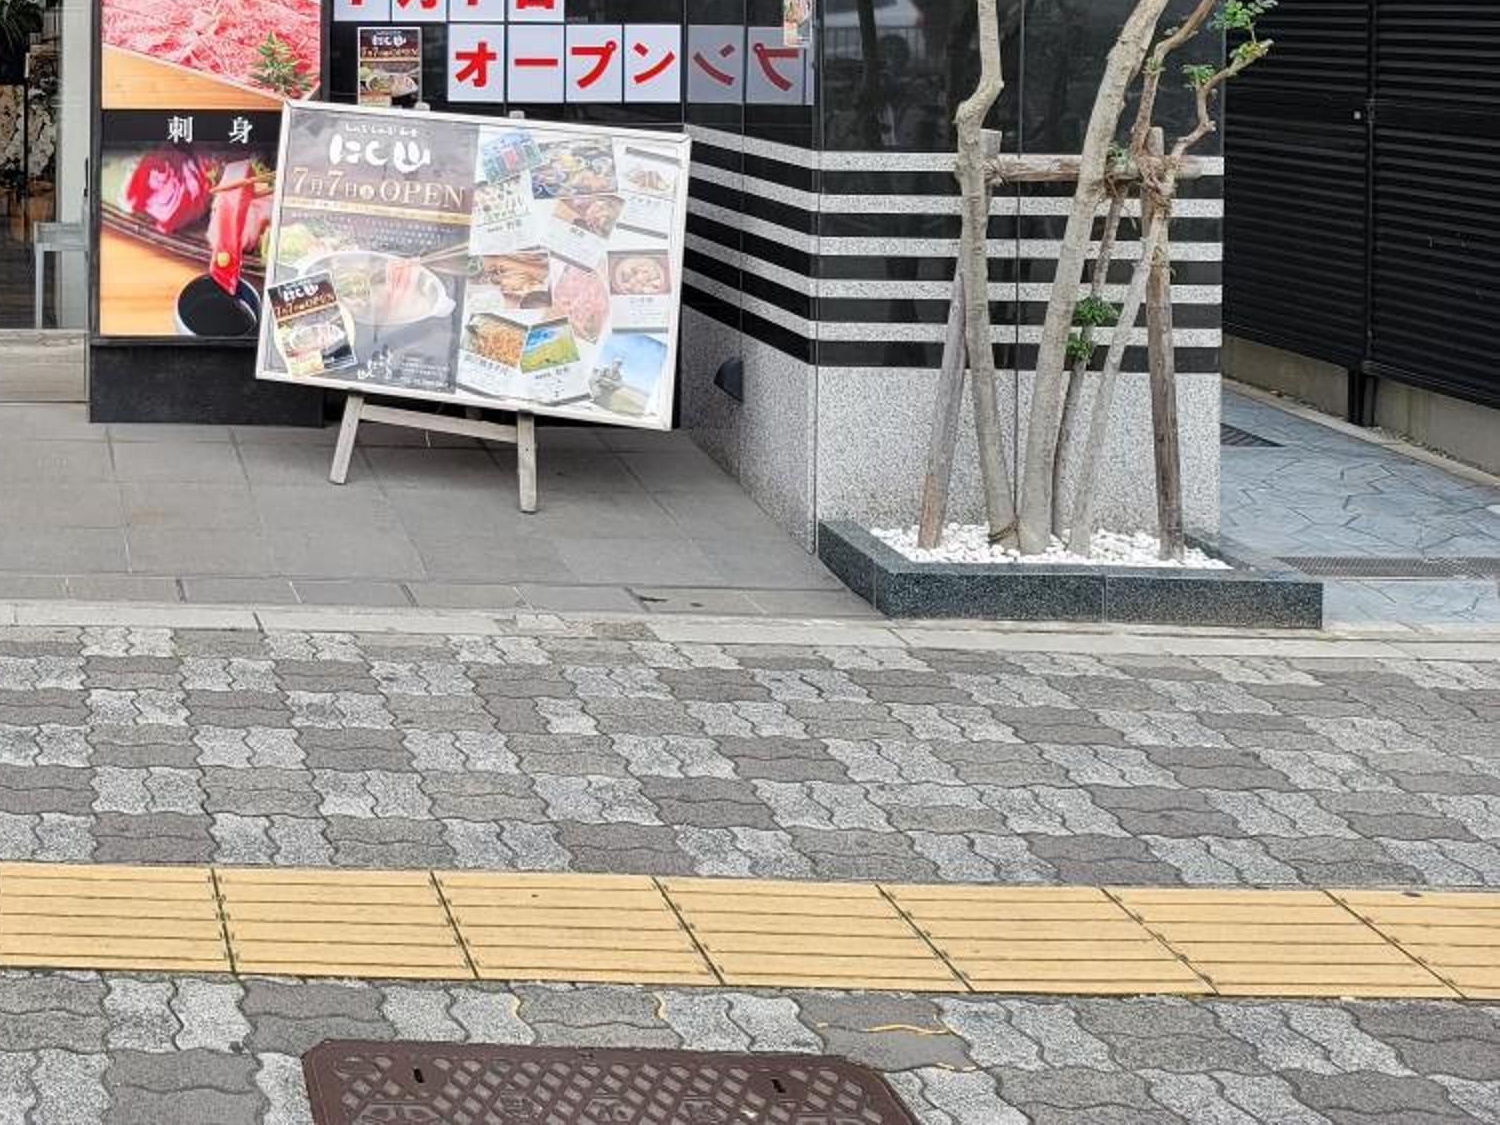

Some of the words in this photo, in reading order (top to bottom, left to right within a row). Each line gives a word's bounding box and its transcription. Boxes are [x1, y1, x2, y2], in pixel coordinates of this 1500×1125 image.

[454, 40, 676, 89] オープン
[166, 115, 254, 144] 刺身
[329, 133, 432, 174] にし山
[379, 177, 466, 209] OPEN
